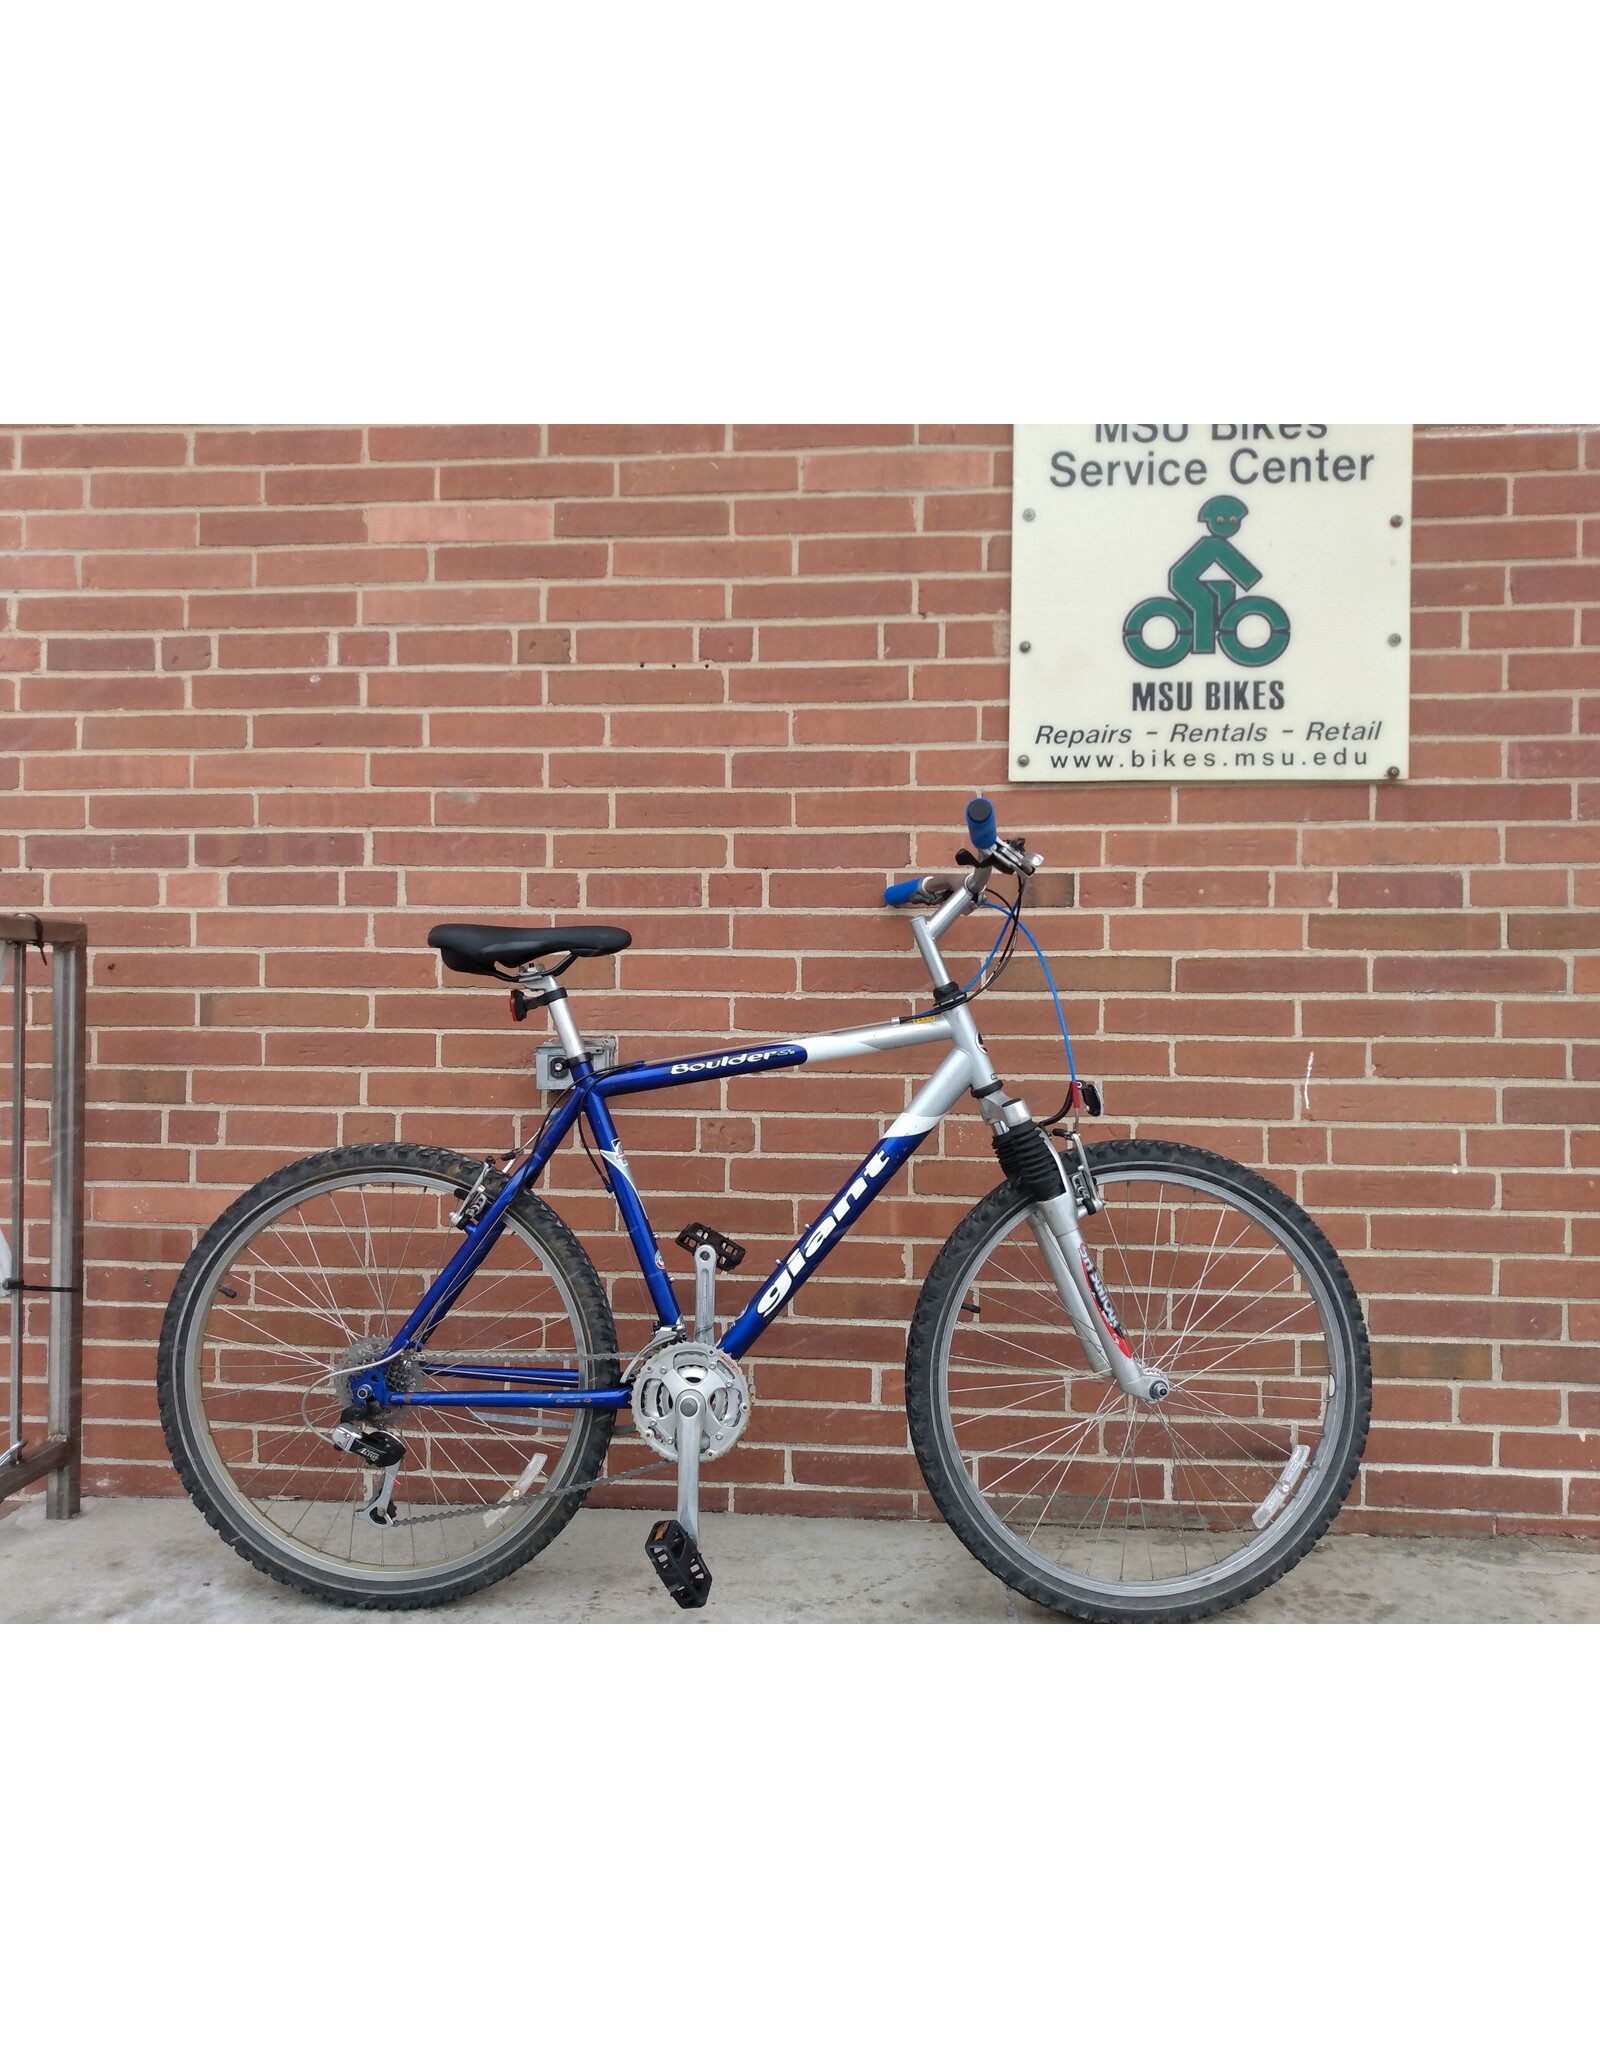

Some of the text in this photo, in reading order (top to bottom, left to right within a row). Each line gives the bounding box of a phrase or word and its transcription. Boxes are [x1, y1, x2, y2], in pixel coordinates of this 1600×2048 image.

[1095, 424, 1189, 443] MSU
[1049, 447, 1375, 488] Service Center
[1132, 680, 1285, 712] MSU BIKES
[1034, 724, 1132, 748] Repairs
[1169, 722, 1268, 743] Rentals
[1305, 720, 1383, 741] Retail
[1050, 747, 1368, 769] www.bikes.msu.edu
[670, 1051, 778, 1075] Boulder
[756, 1149, 891, 1318] giant
